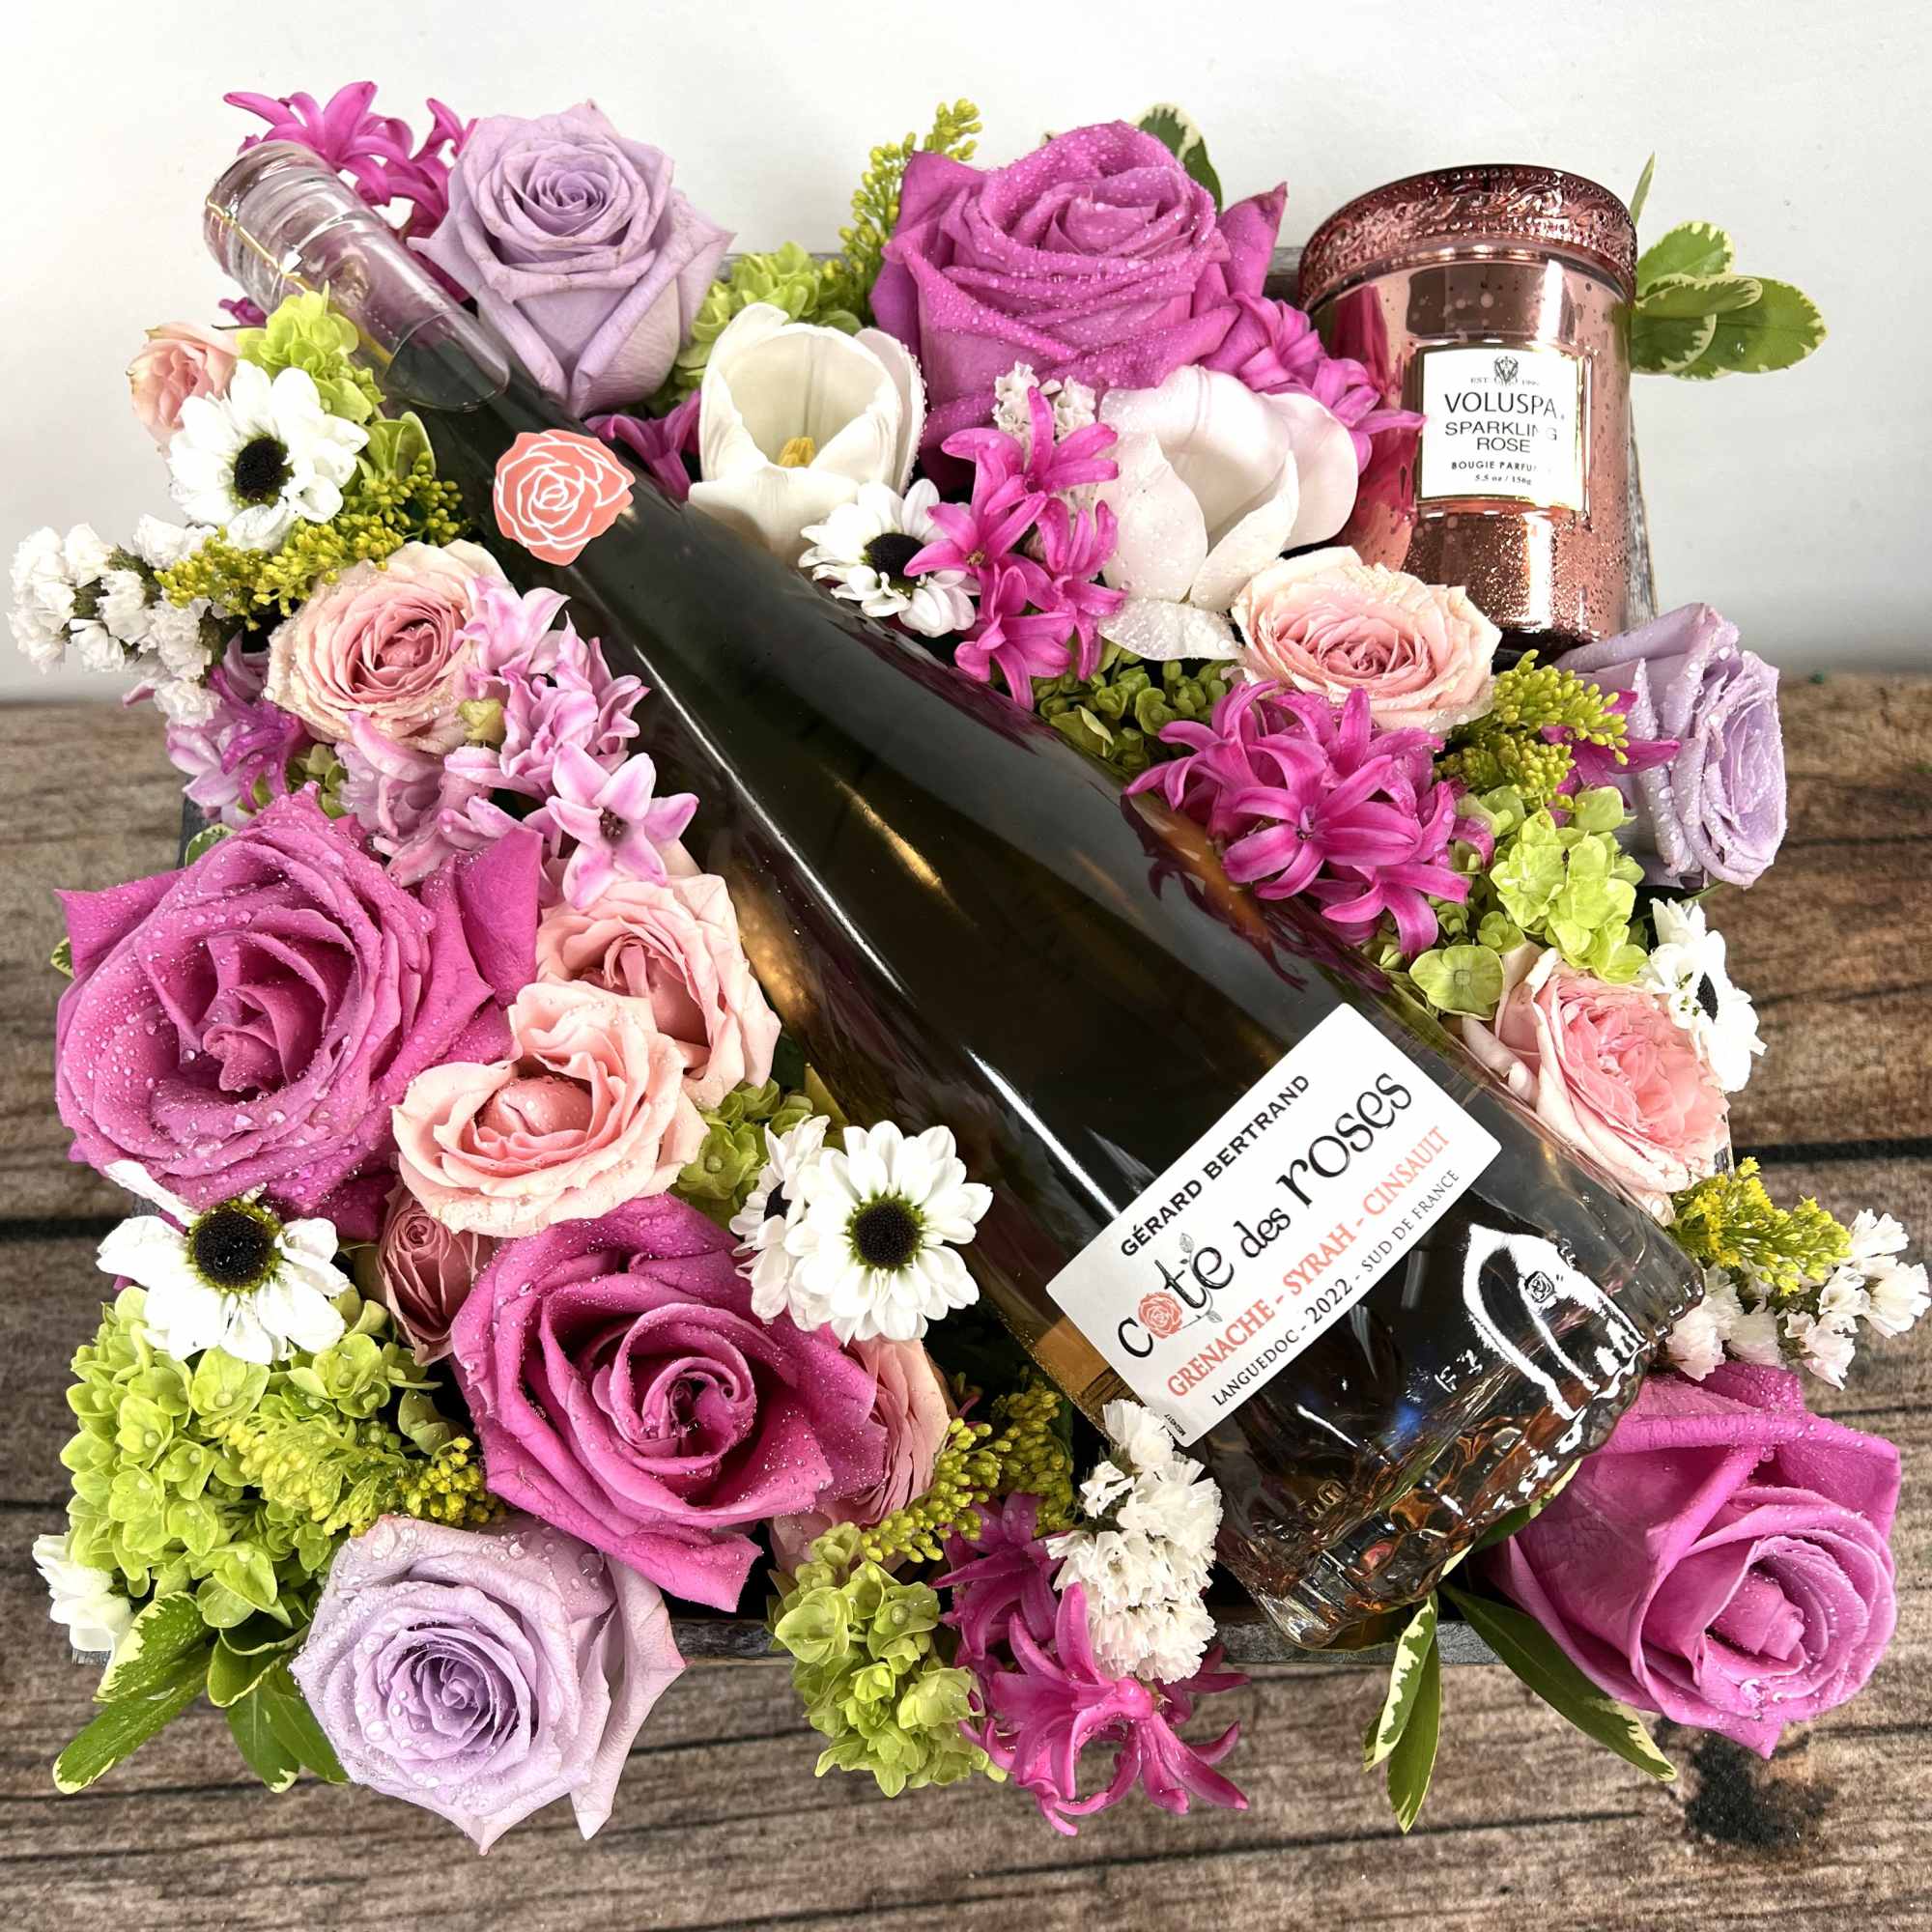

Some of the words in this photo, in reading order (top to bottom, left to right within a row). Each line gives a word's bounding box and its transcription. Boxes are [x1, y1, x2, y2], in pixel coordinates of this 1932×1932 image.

[1444, 391, 1557, 418] VOLUSPA
[1451, 461, 1495, 470] BOUGIE
[1499, 461, 1539, 471] PARFU
[1476, 437, 1531, 453] ROSE
[1121, 1179, 1203, 1256] GÉRARD
[1203, 1075, 1309, 1180] BERTRAND
[1234, 1208, 1292, 1259] des
[1275, 1073, 1412, 1208] roses
[1167, 1298, 1276, 1396] GRENACHE
[1283, 1223, 1357, 1295] SYRAH
[1362, 1125, 1450, 1215] CINSAULT
[1211, 1329, 1299, 1406] LANGUEDOC
[1305, 1278, 1353, 1324] 2022
[1361, 1240, 1393, 1272] SUD
[1391, 1218, 1415, 1240] DE
[1411, 1170, 1460, 1220] FRANCE
